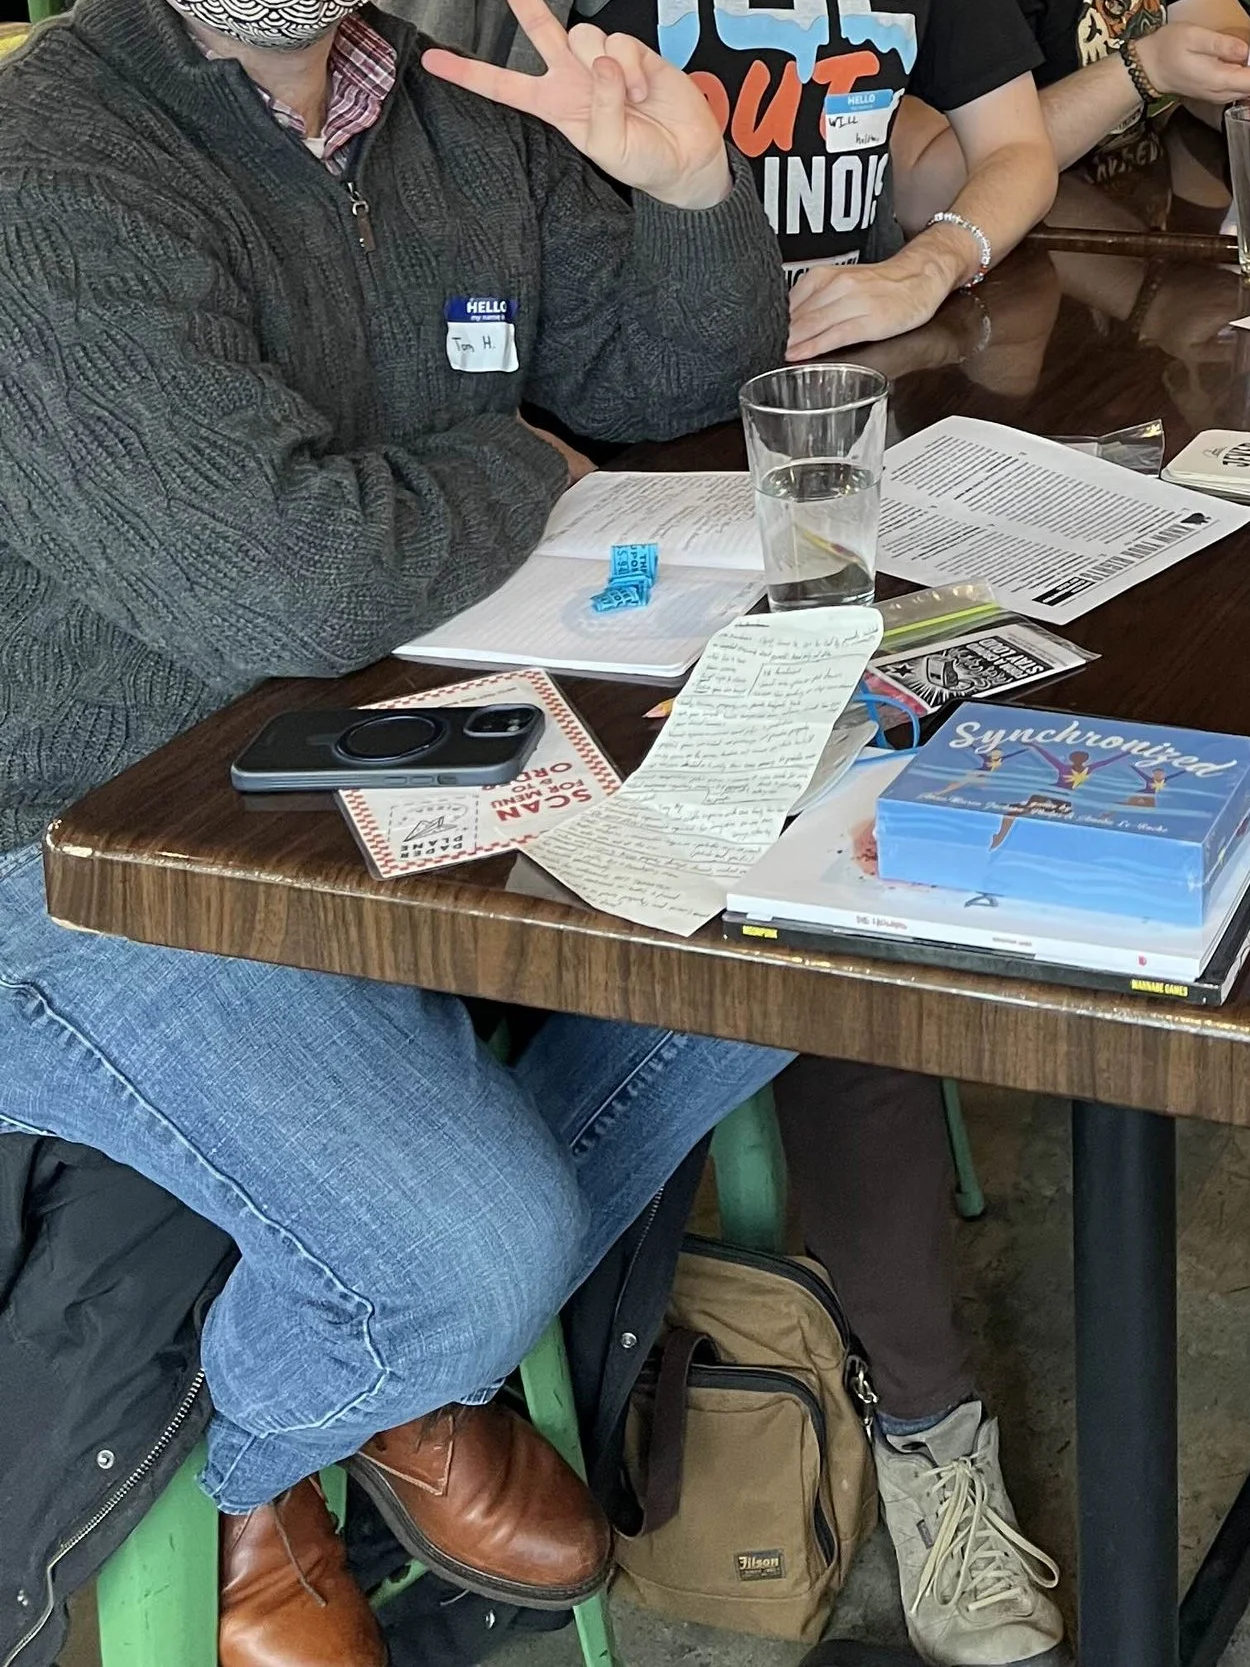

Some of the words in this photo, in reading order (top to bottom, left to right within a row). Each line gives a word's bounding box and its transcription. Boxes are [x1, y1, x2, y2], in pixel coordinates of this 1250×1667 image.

[847, 93, 876, 106] HELLO
[467, 300, 507, 314] HELLO
[978, 638, 1017, 658] LOUD
[1005, 654, 1044, 675] STAY
[949, 720, 1238, 778] Synchronized
[548, 778, 585, 795] FOR
[491, 788, 545, 809] MENU
[497, 787, 593, 823] SCAN
[1164, 983, 1189, 997] GAMES
[738, 1556, 779, 1570] Filson
